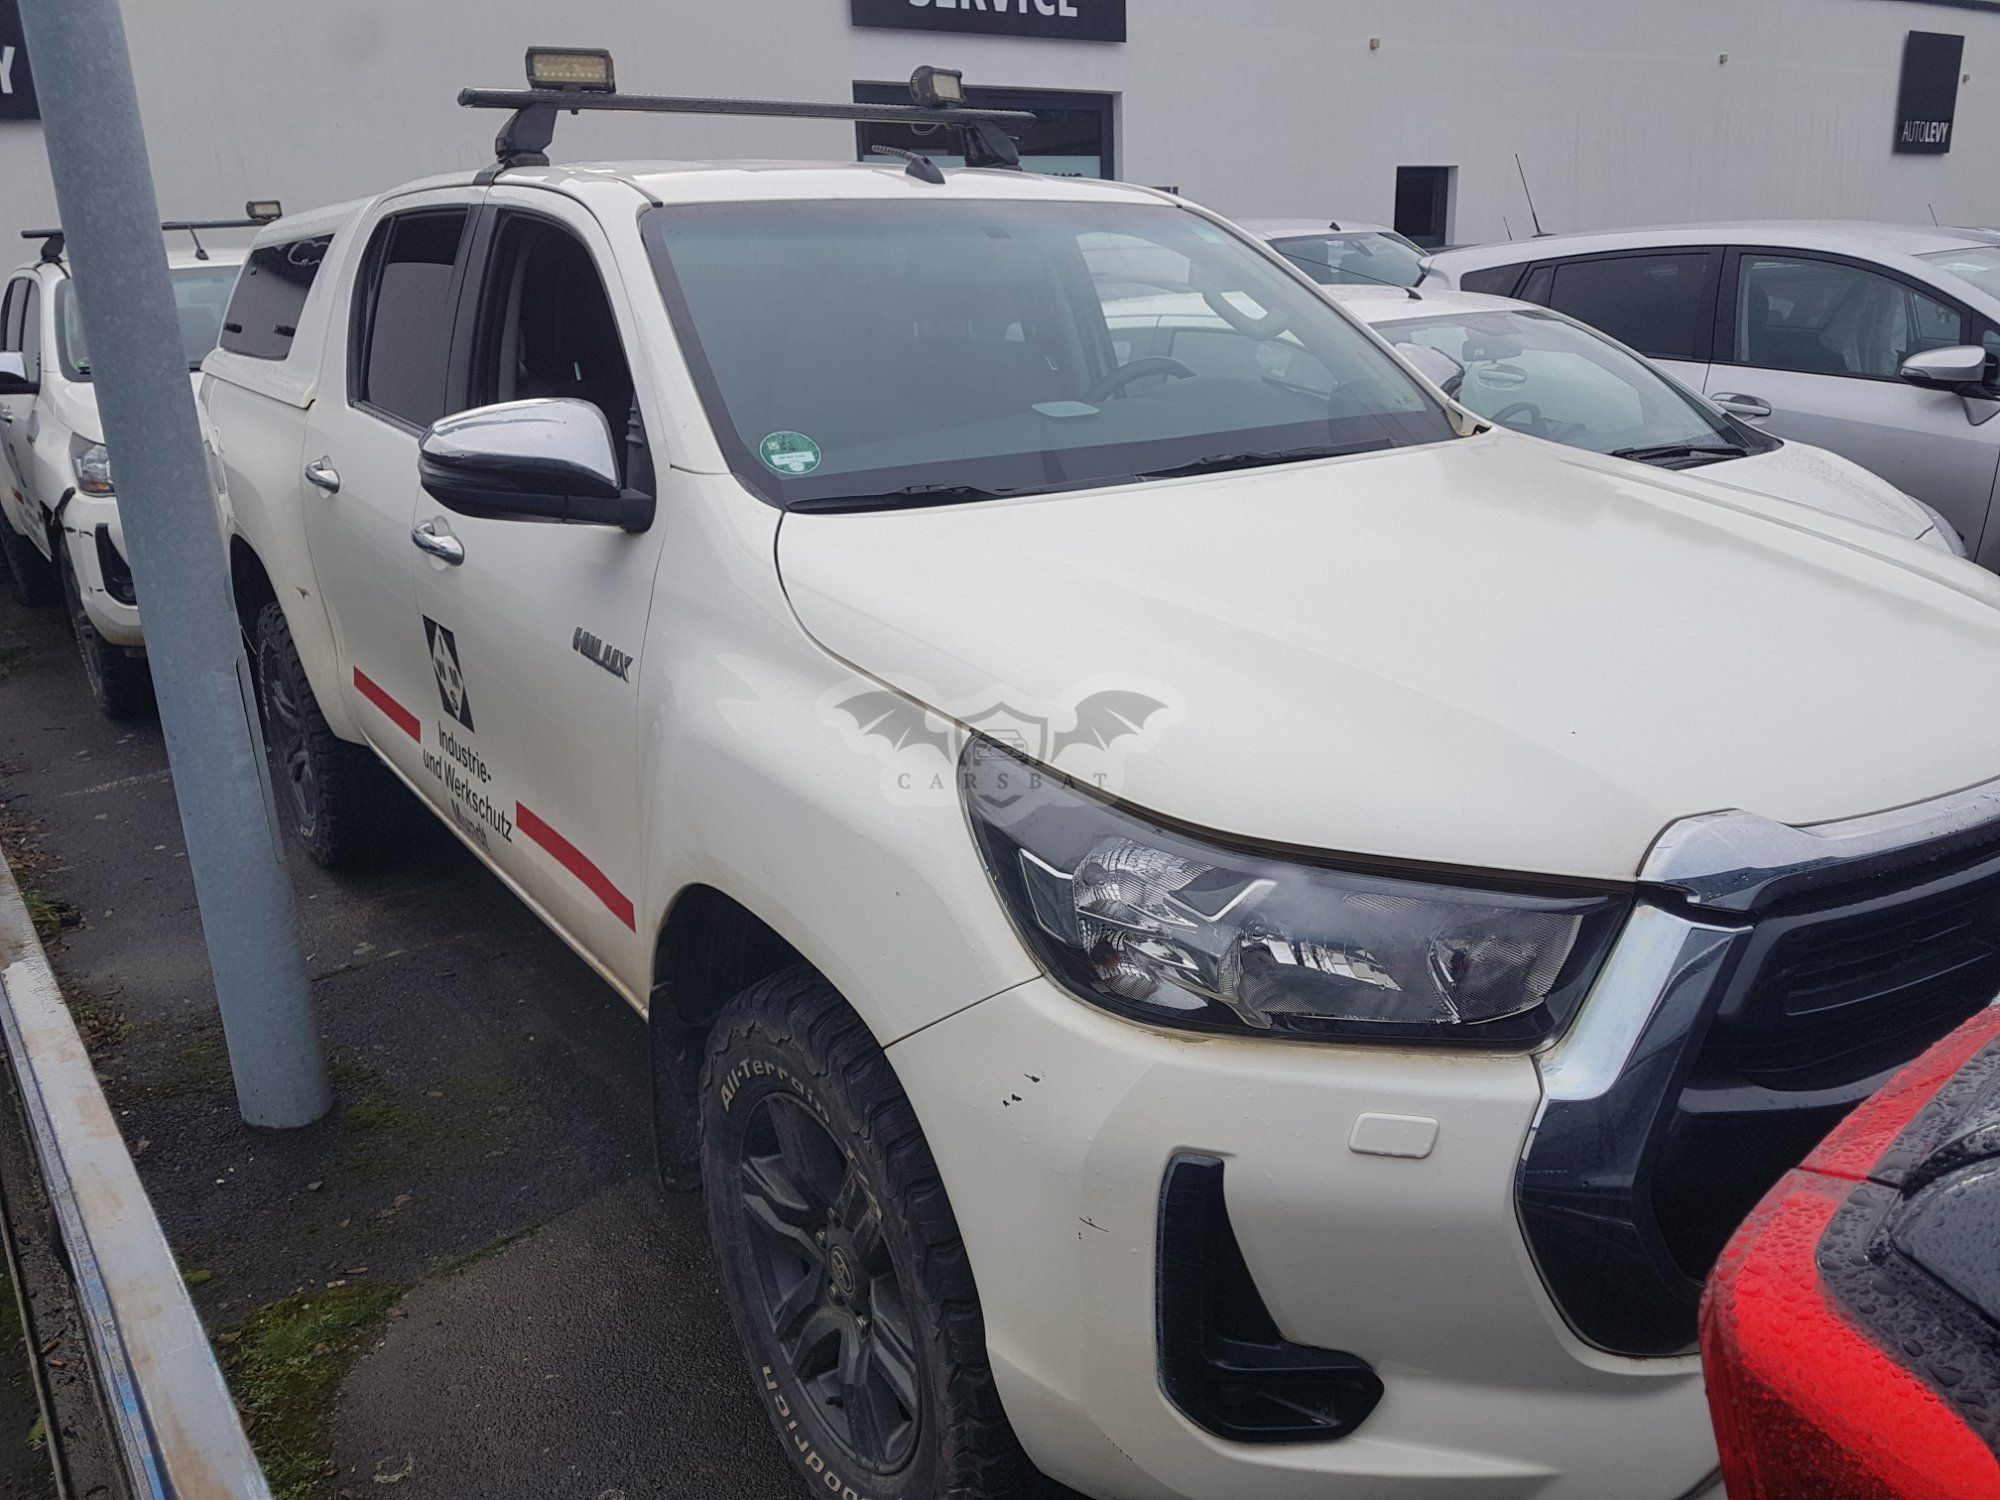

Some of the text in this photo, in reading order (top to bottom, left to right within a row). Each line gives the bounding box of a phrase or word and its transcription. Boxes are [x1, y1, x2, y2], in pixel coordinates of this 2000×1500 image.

[1901, 120, 1949, 143] AUTOLEVY
[573, 626, 633, 683] HILUX
[438, 720, 491, 783] Industrie-
[423, 748, 512, 843] und Werkschutz
[762, 1366, 862, 1500] oodrich
